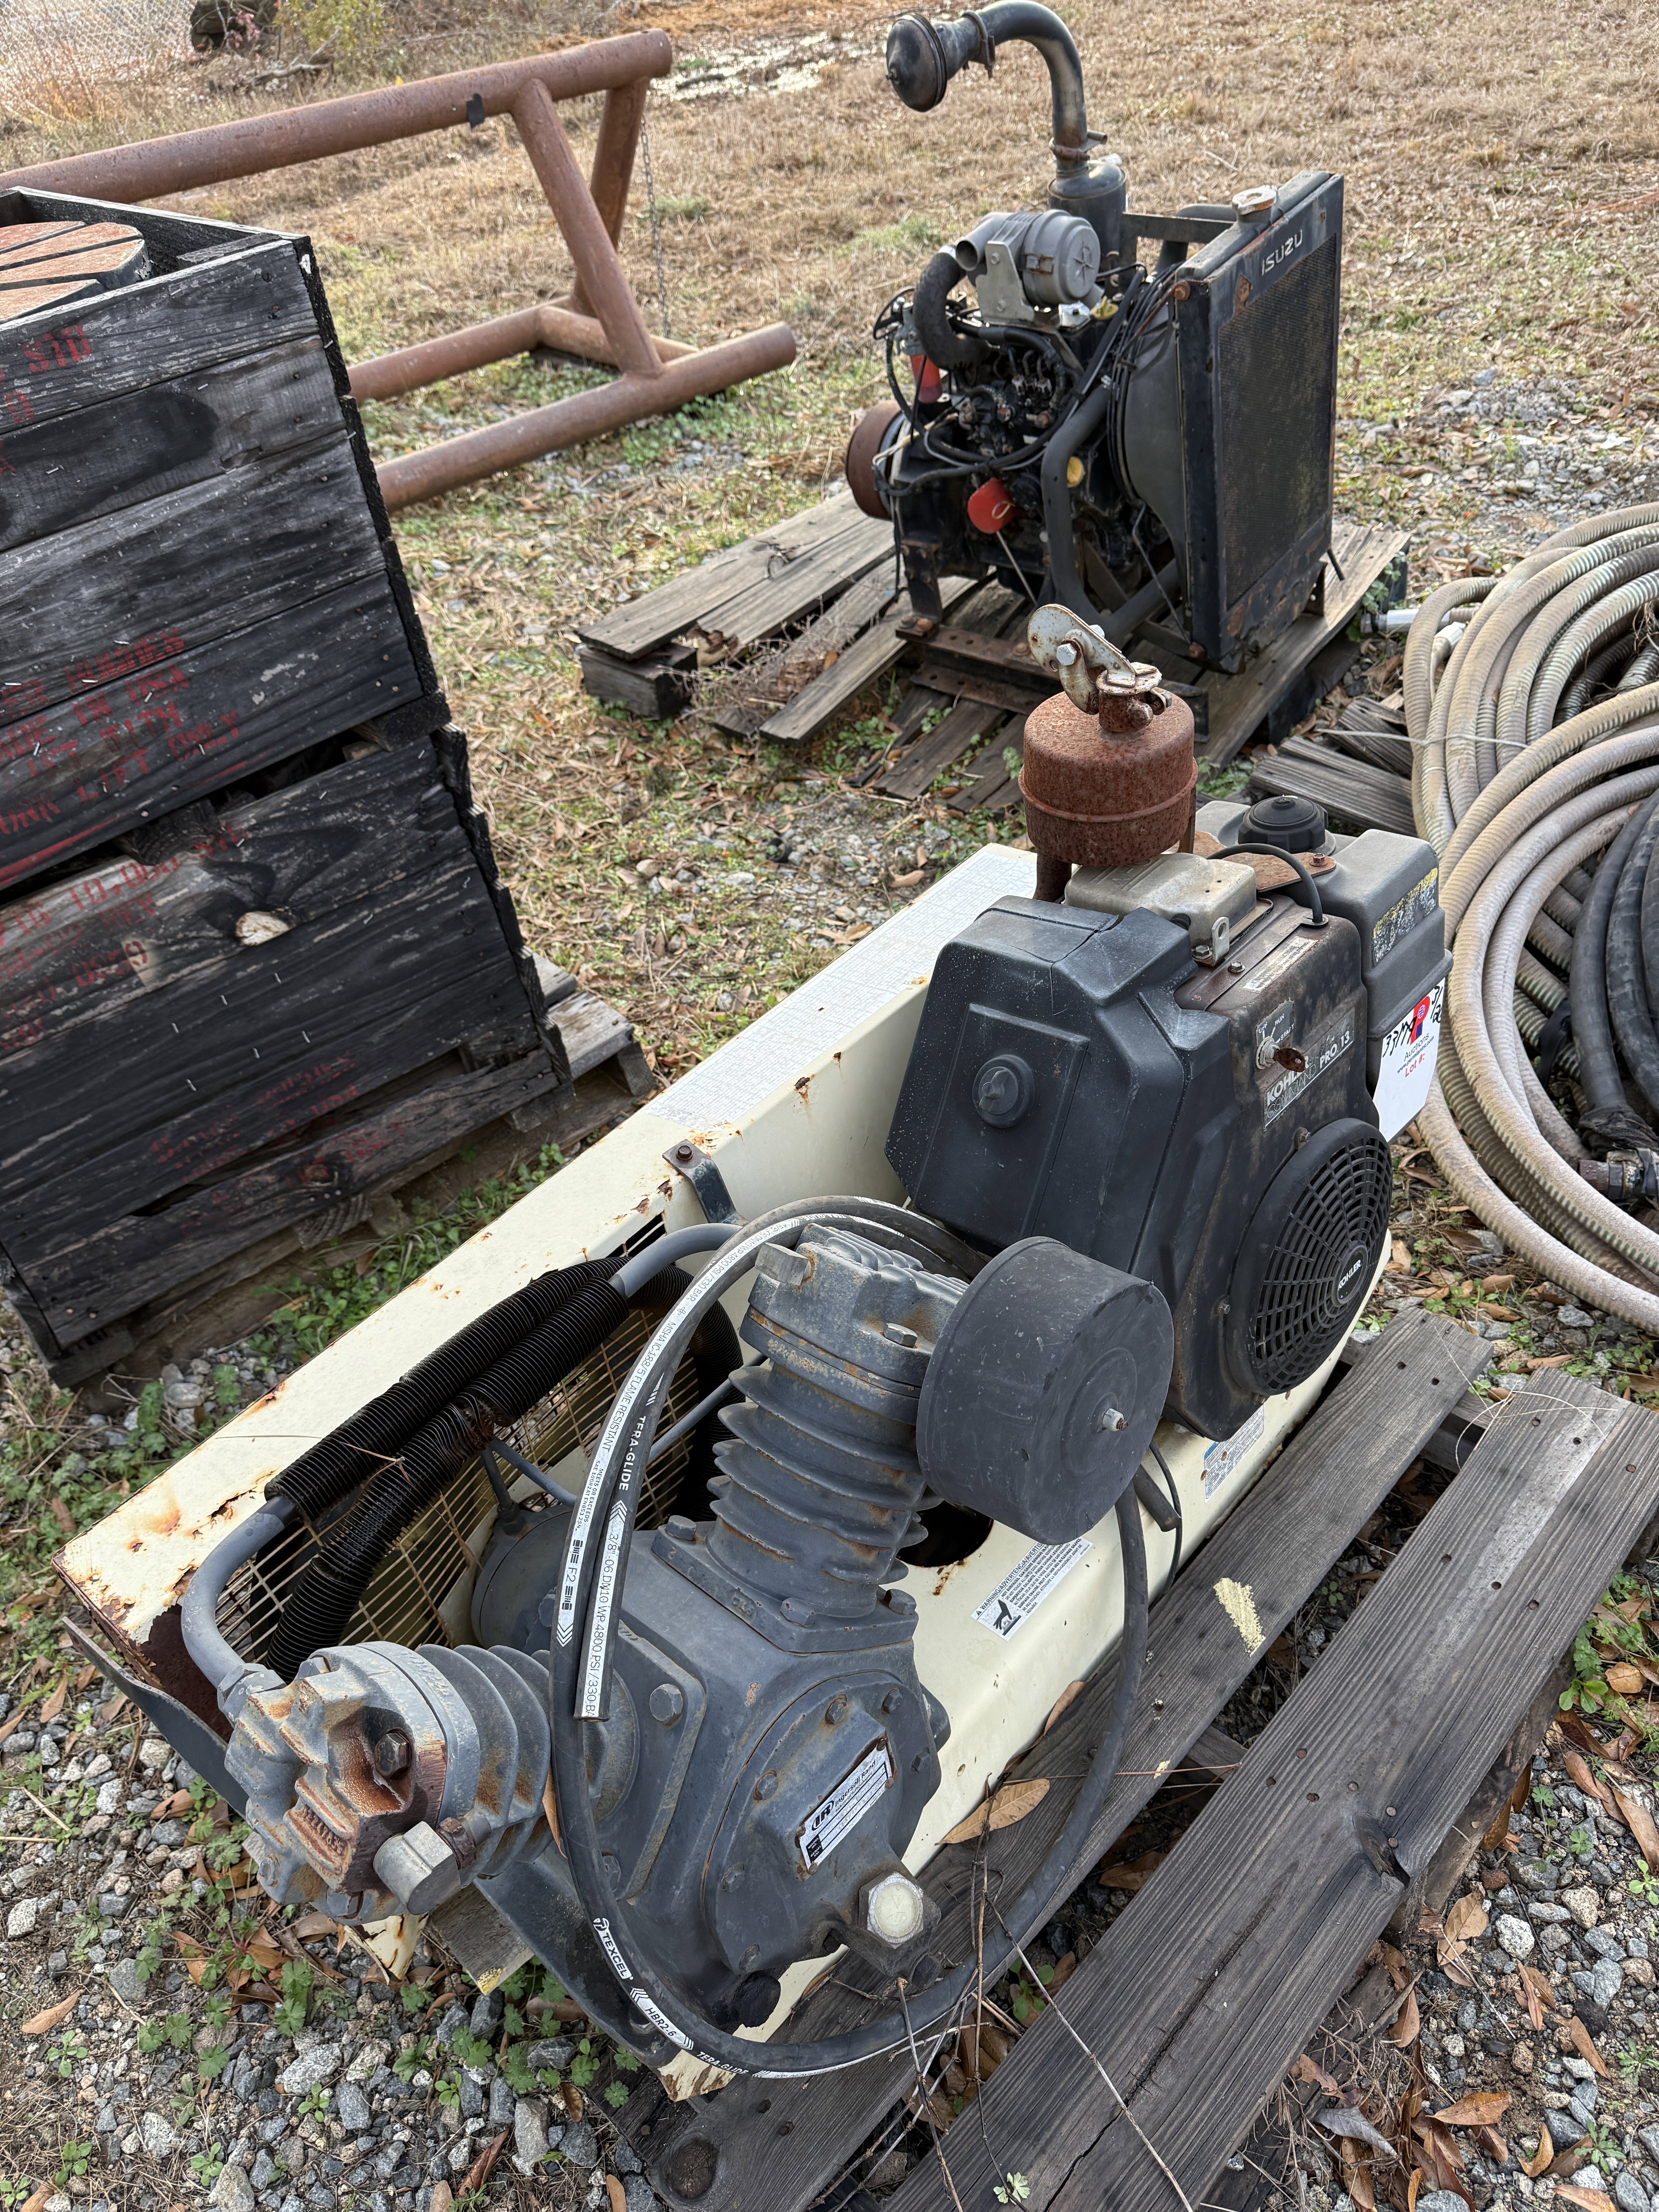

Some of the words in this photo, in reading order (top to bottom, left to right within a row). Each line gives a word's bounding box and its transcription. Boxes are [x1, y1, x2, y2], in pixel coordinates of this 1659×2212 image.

[1261, 229, 1302, 276] ISUZU
[1274, 1013, 1285, 1027] RUN
[1280, 1023, 1295, 1041] START
[1320, 1044, 1338, 1068] PRO
[1341, 1030, 1350, 1047] 13
[1404, 1033, 1429, 1061] Auctions
[1405, 1060, 1417, 1078] Lot
[1419, 1053, 1425, 1065] #:
[724, 1252, 738, 1266] 4800
[737, 1243, 749, 1255] WP
[714, 1264, 725, 1274] PSI
[1338, 1259, 1361, 1291] KOHLER
[699, 1276, 712, 1289] 330
[687, 1288, 702, 1302] BAR
[657, 1321, 676, 1341] MSHA
[621, 1376, 642, 1404] FLAME
[602, 1405, 627, 1452] RESISTANT
[619, 1416, 646, 1491] TERA-GLIDE
[594, 1468, 604, 1487] MEETS
[592, 1487, 598, 1495] OR
[584, 1496, 595, 1523] EXCEEDS
[566, 1567, 577, 1582] F2
[597, 1606, 608, 1622] WP
[592, 1624, 604, 1652] 4800
[590, 1655, 601, 1671] PSI
[587, 1680, 598, 1702] 330
[836, 1777, 860, 1807] Ingersoll
[862, 1759, 875, 1779] Rand
[816, 1805, 831, 1827] IR
[603, 1933, 627, 1976] TEXCEL
[645, 2008, 677, 2037] HBR2-6
[697, 2051, 749, 2074] TERA-GLIDE
